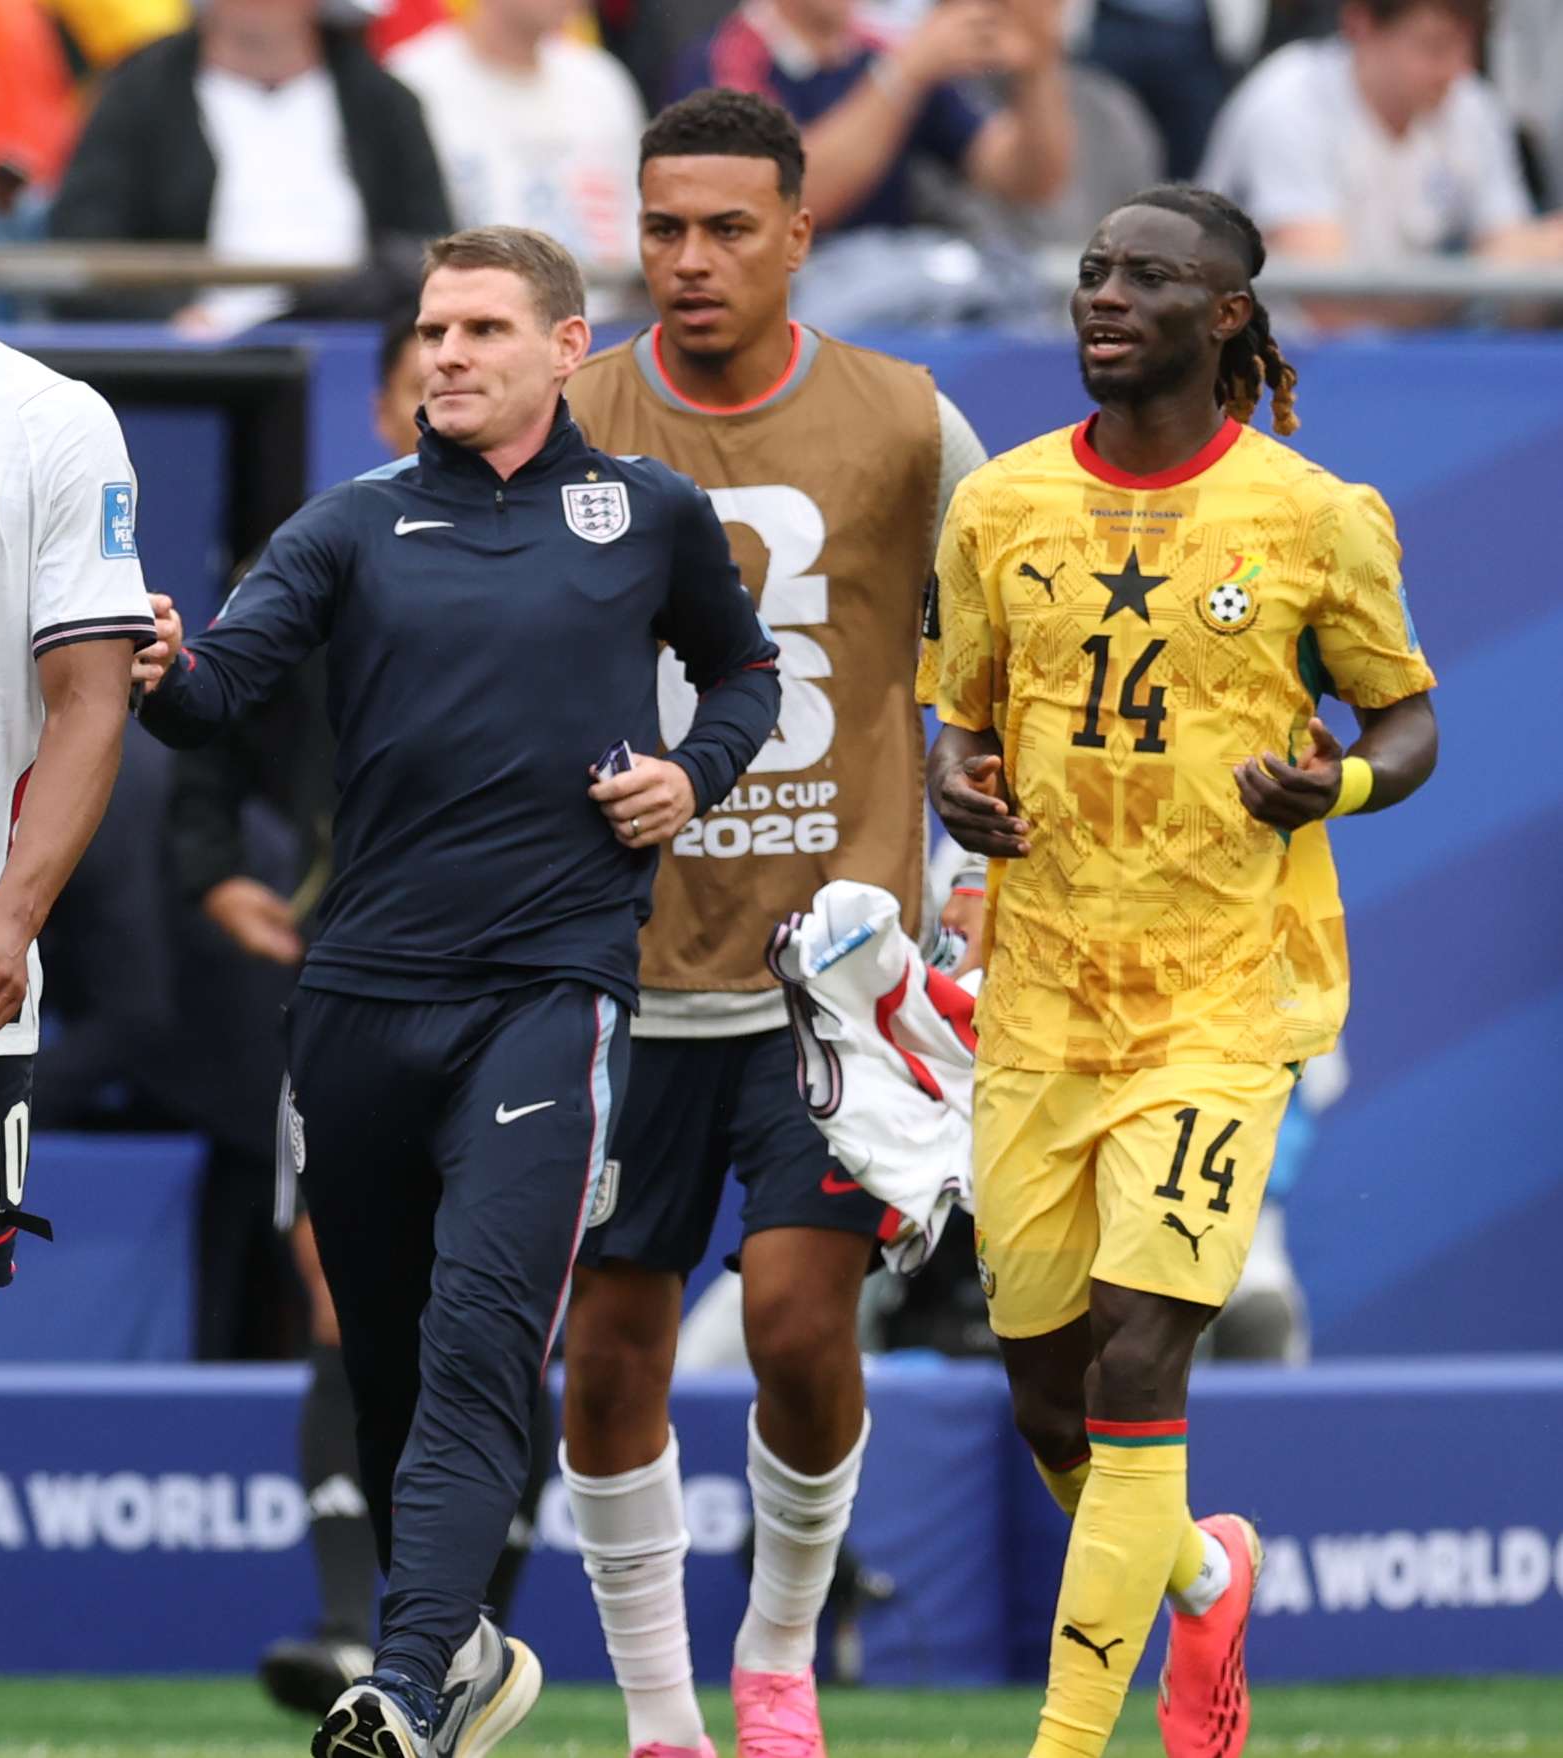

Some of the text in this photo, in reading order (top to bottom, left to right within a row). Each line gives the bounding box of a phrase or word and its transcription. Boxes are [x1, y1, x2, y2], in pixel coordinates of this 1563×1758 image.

[1072, 633, 1168, 753] 14
[672, 811, 838, 859] 2026
[775, 781, 838, 810] CUP
[1153, 1107, 1243, 1214] 14
[26, 1472, 311, 1551] WORLD
[1310, 1526, 1551, 1615] WORLD
